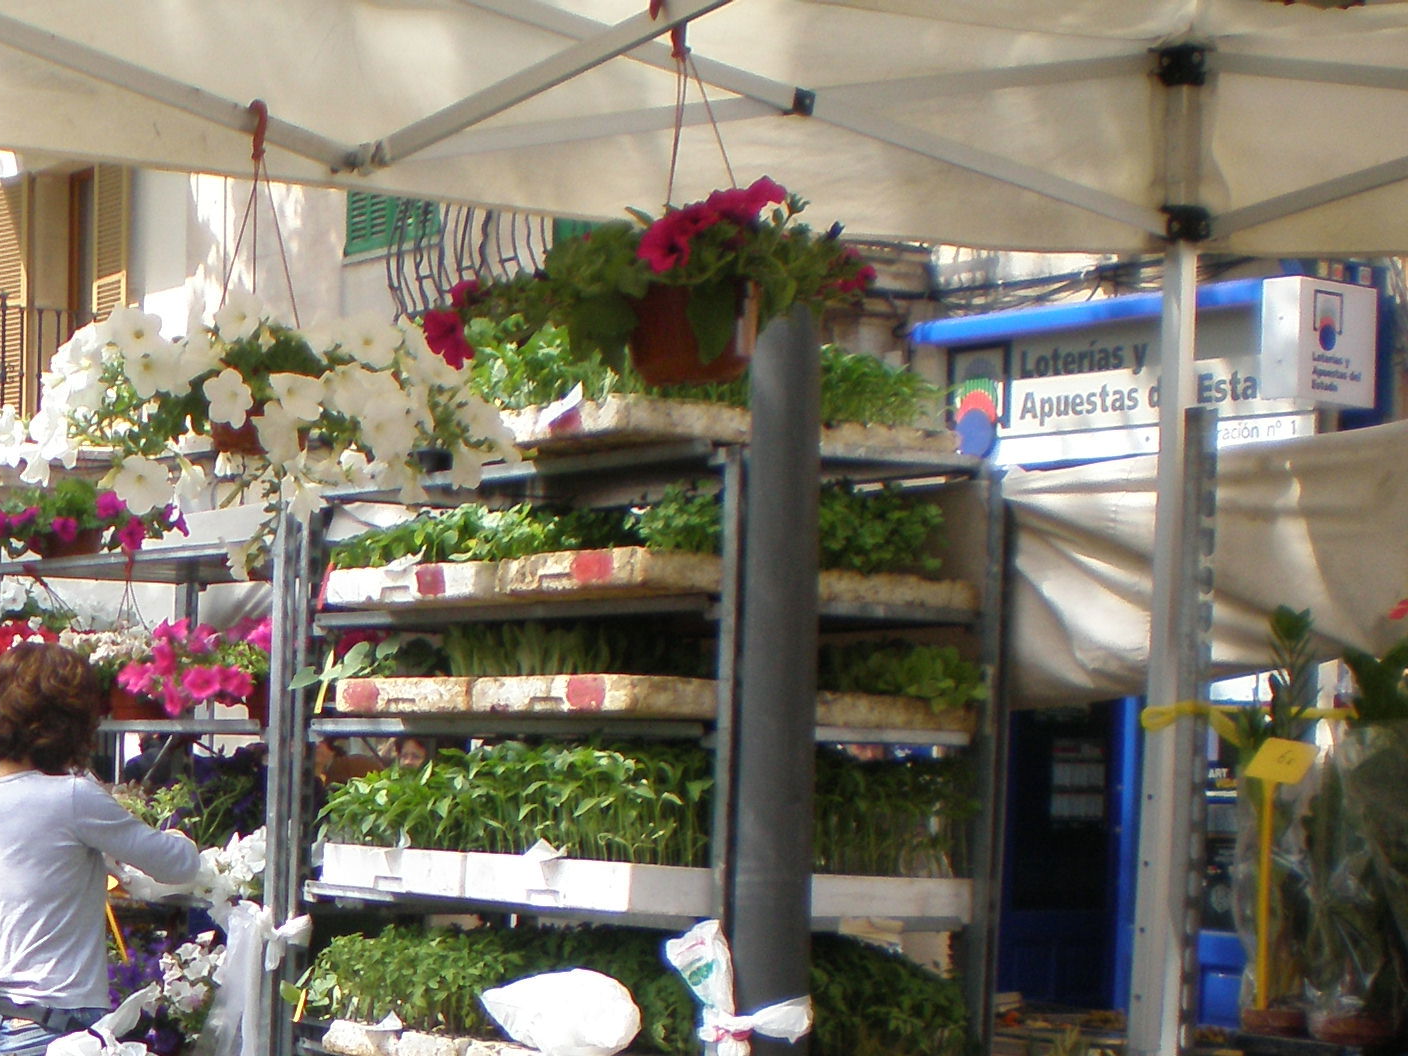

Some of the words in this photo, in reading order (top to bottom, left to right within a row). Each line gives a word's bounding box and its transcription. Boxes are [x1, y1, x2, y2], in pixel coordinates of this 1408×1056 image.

[1020, 340, 1124, 378] Loterías
[1133, 342, 1149, 375] y
[1019, 383, 1140, 427] Apuestas
[1197, 369, 1259, 403] Esta
